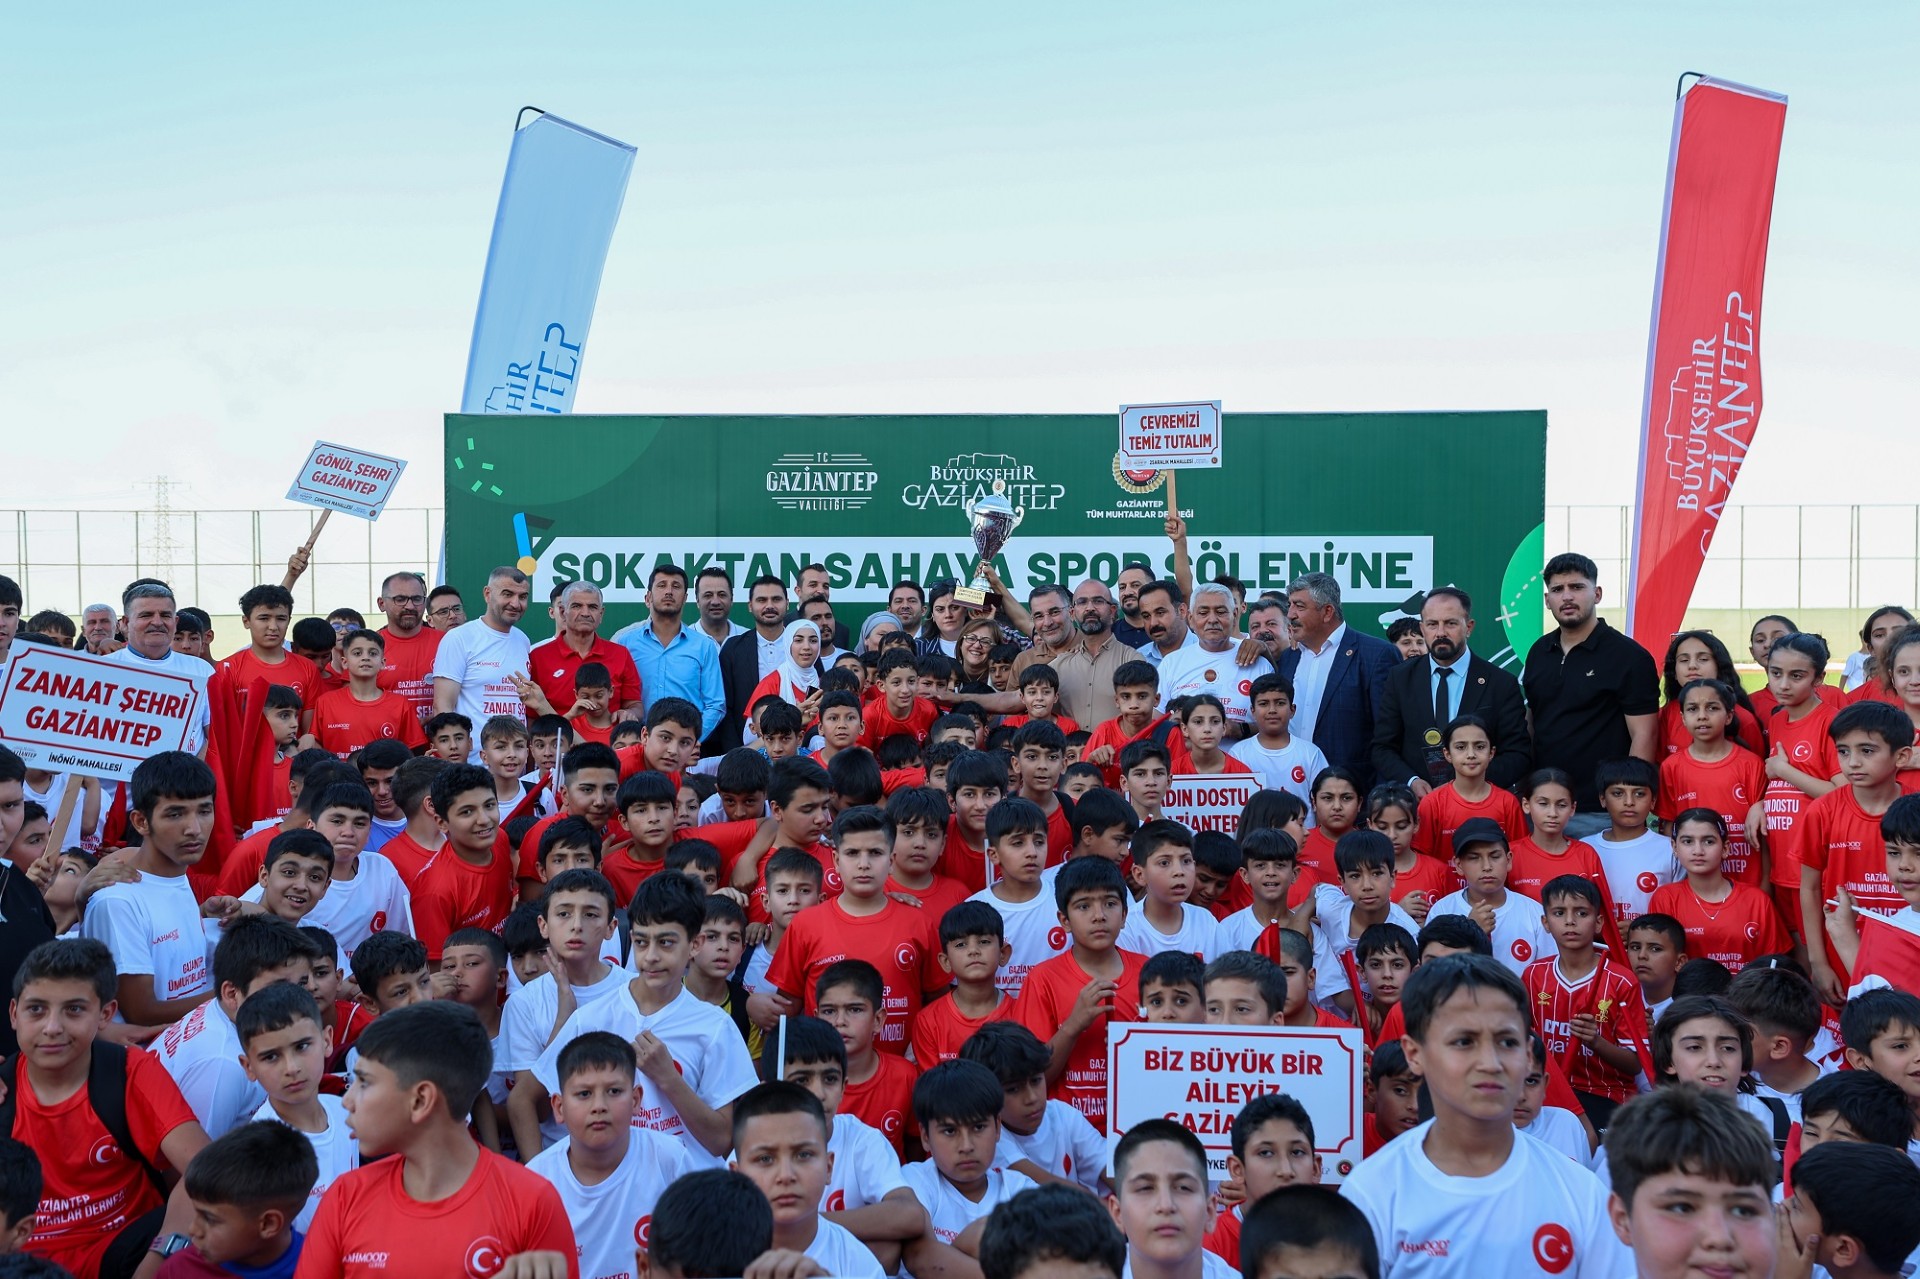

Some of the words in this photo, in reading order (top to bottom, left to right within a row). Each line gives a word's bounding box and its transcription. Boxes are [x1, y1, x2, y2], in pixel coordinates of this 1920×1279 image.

[1140, 411, 1200, 432] ÇEVREMİZİ
[1677, 334, 1717, 513] BÜYÜKŞEHİR
[1129, 432, 1162, 451] TEMİZ
[1164, 433, 1212, 449] TUTALIM
[315, 453, 354, 473] GÖNÜL
[354, 463, 393, 481] ŞEHRİ
[817, 452, 828, 463] TC
[311, 471, 378, 495] GAZİANTEP
[766, 466, 878, 492] GAZİANTEP
[930, 465, 1038, 483] BÜYÜKŞEHİR
[1086, 509, 1104, 519] TÜM
[1105, 510, 1157, 519] MUHTARLAR
[1157, 508, 1195, 519] DEEĞİ
[1116, 499, 1164, 508] GAZİANTEP
[15, 666, 119, 706] ZANAAT
[119, 687, 190, 719] ŞEHRİ
[483, 701, 516, 715] ZANAAT
[25, 706, 162, 747] GAZİANTEP
[48, 751, 76, 765] İNÖNÜ
[76, 757, 122, 773] MAHALLESİ
[1197, 788, 1249, 807] DOSTU
[1771, 799, 1799, 813] DOSTU
[1144, 1046, 1184, 1072] BİZ
[1190, 1048, 1275, 1074] BÜYÜK
[1281, 1050, 1323, 1076] BİR
